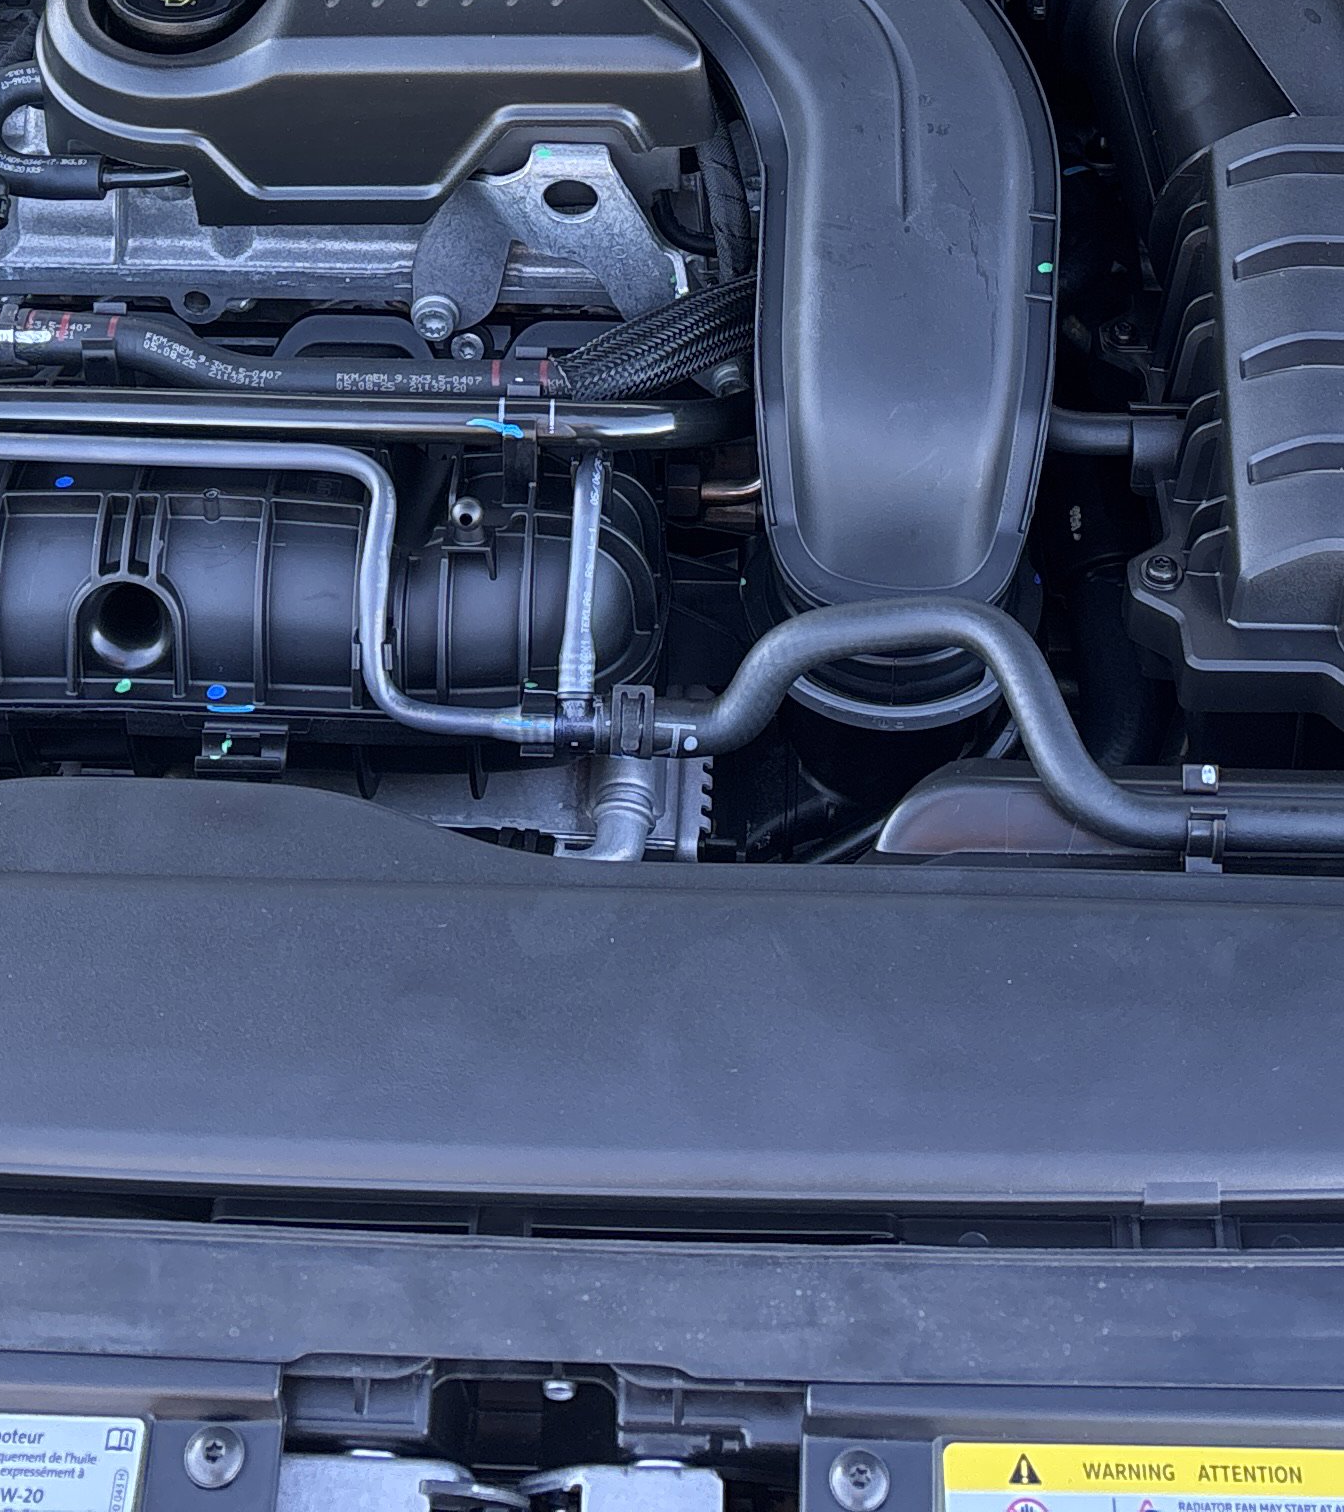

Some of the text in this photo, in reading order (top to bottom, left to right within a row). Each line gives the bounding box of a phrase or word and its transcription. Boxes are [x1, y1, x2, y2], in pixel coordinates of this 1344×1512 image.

[144, 331, 194, 358] FKM/AEM
[142, 340, 198, 370] 05.08.25
[335, 372, 388, 384] FKM/AEM
[335, 380, 396, 392] 05.08.25
[48, 1451, 63, 1464] de
[0, 1465, 76, 1480] expressément
[77, 1467, 86, 1479] à
[1082, 1461, 1304, 1485] WARNING ATTENTION
[1177, 1500, 1233, 1512] RADIATOR
